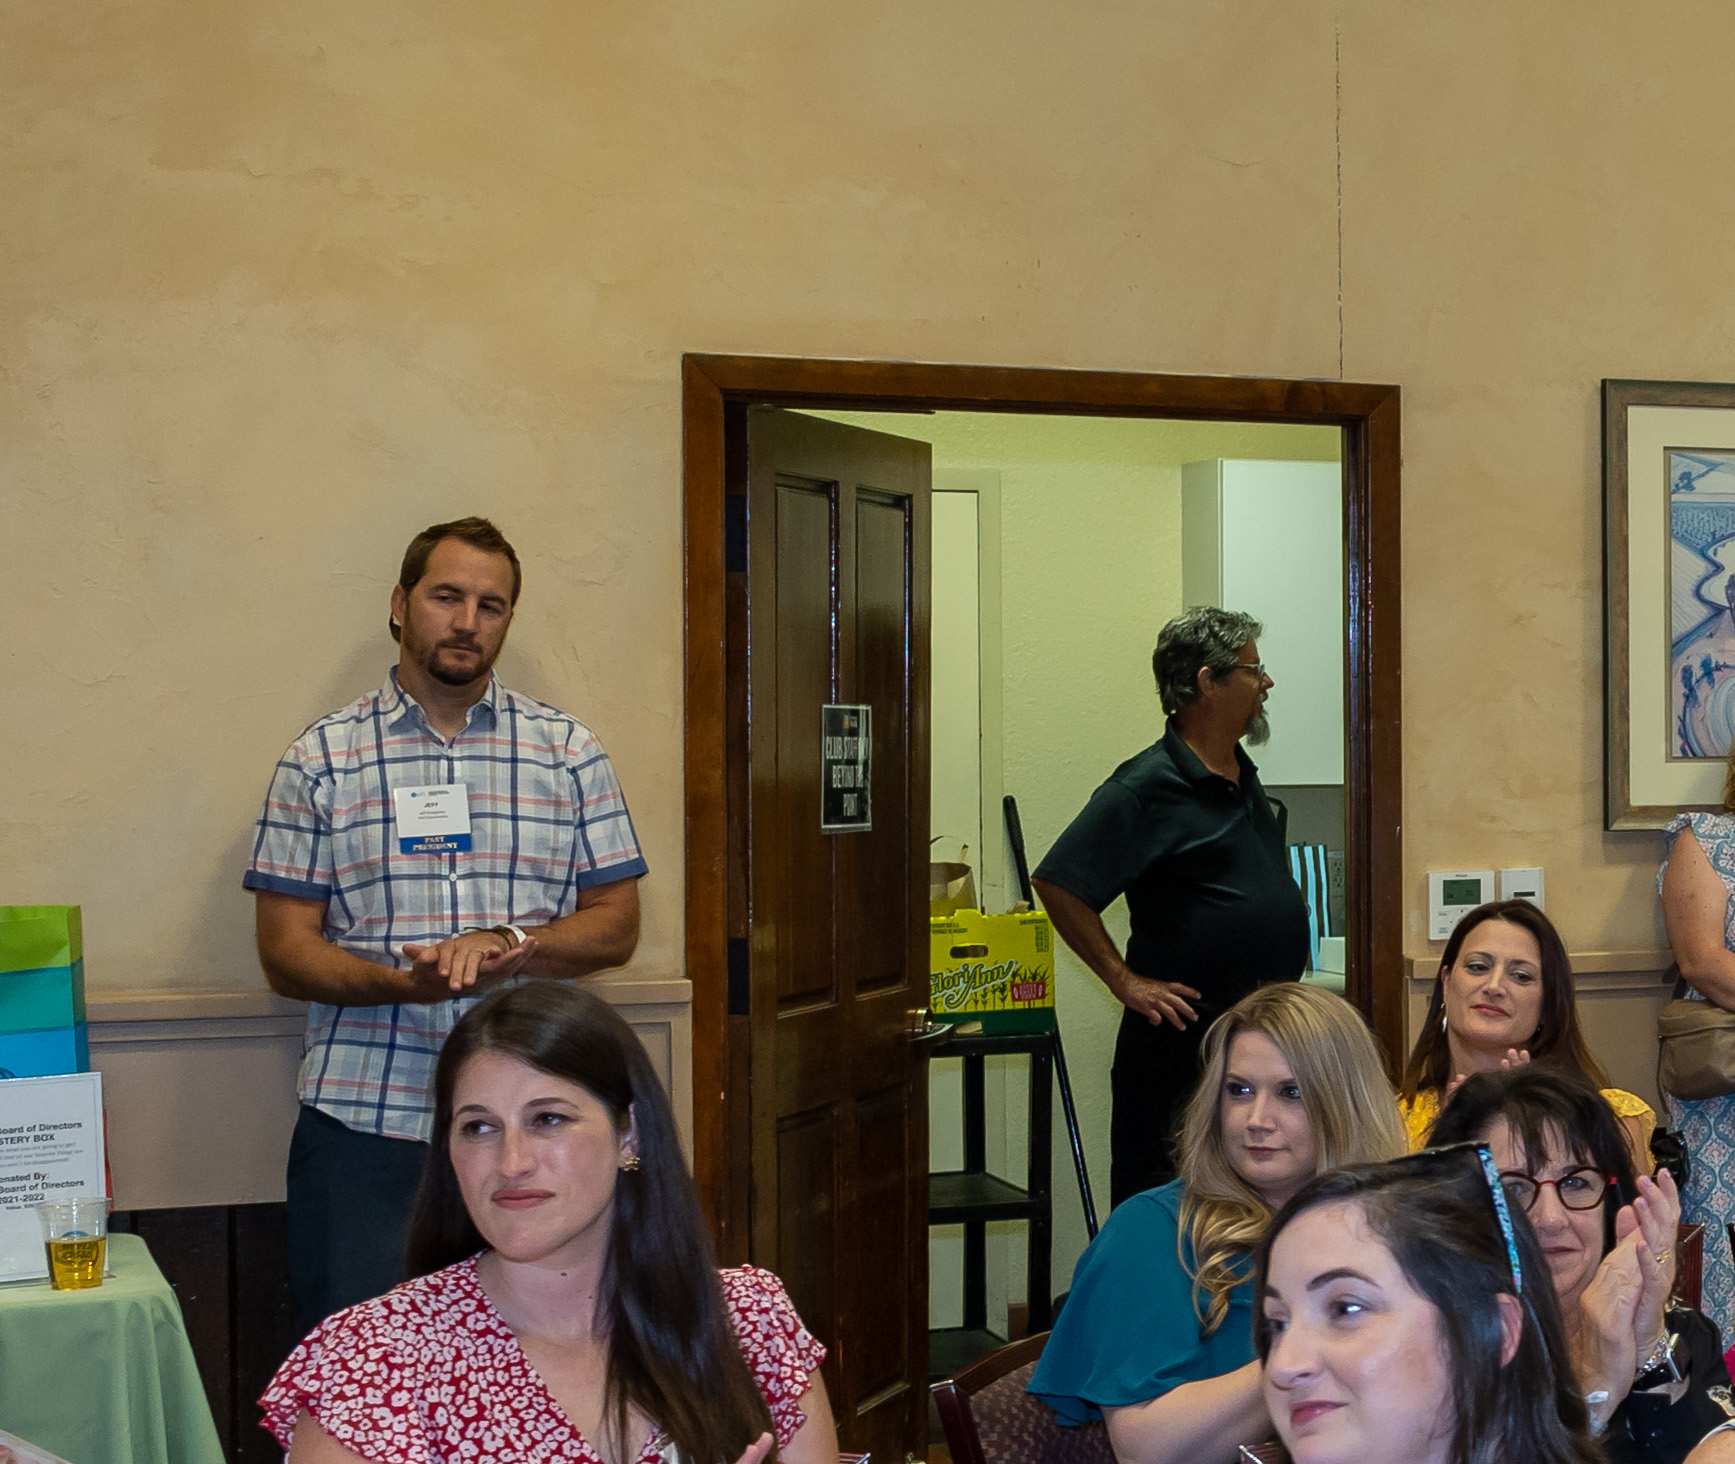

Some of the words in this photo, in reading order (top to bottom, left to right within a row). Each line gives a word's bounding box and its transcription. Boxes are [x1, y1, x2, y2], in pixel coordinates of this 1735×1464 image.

[39, 1122, 82, 1131] Directors
[34, 1134, 55, 1142] BOX
[42, 1180, 85, 1189] Directors
